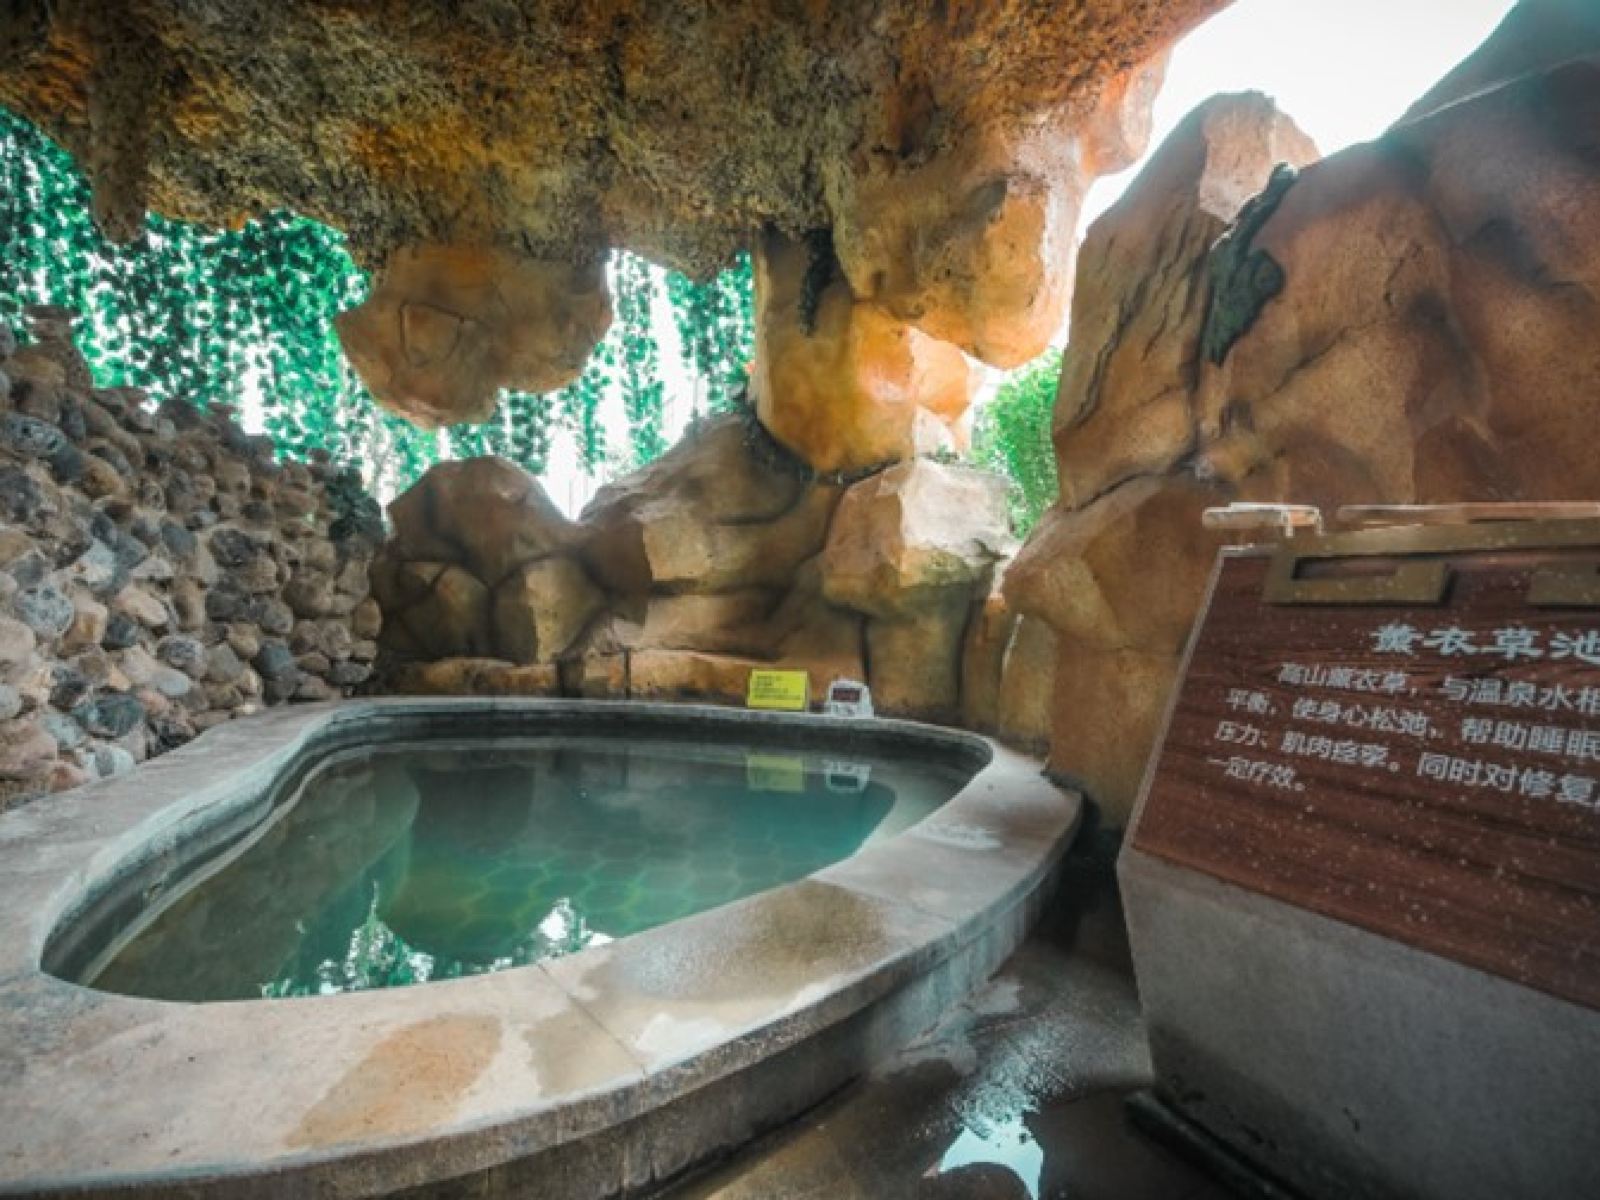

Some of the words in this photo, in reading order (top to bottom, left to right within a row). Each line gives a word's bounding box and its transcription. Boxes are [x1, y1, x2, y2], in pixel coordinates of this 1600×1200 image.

[1214, 720, 1600, 810] 压力、肌肉痉挛。同时对修复
